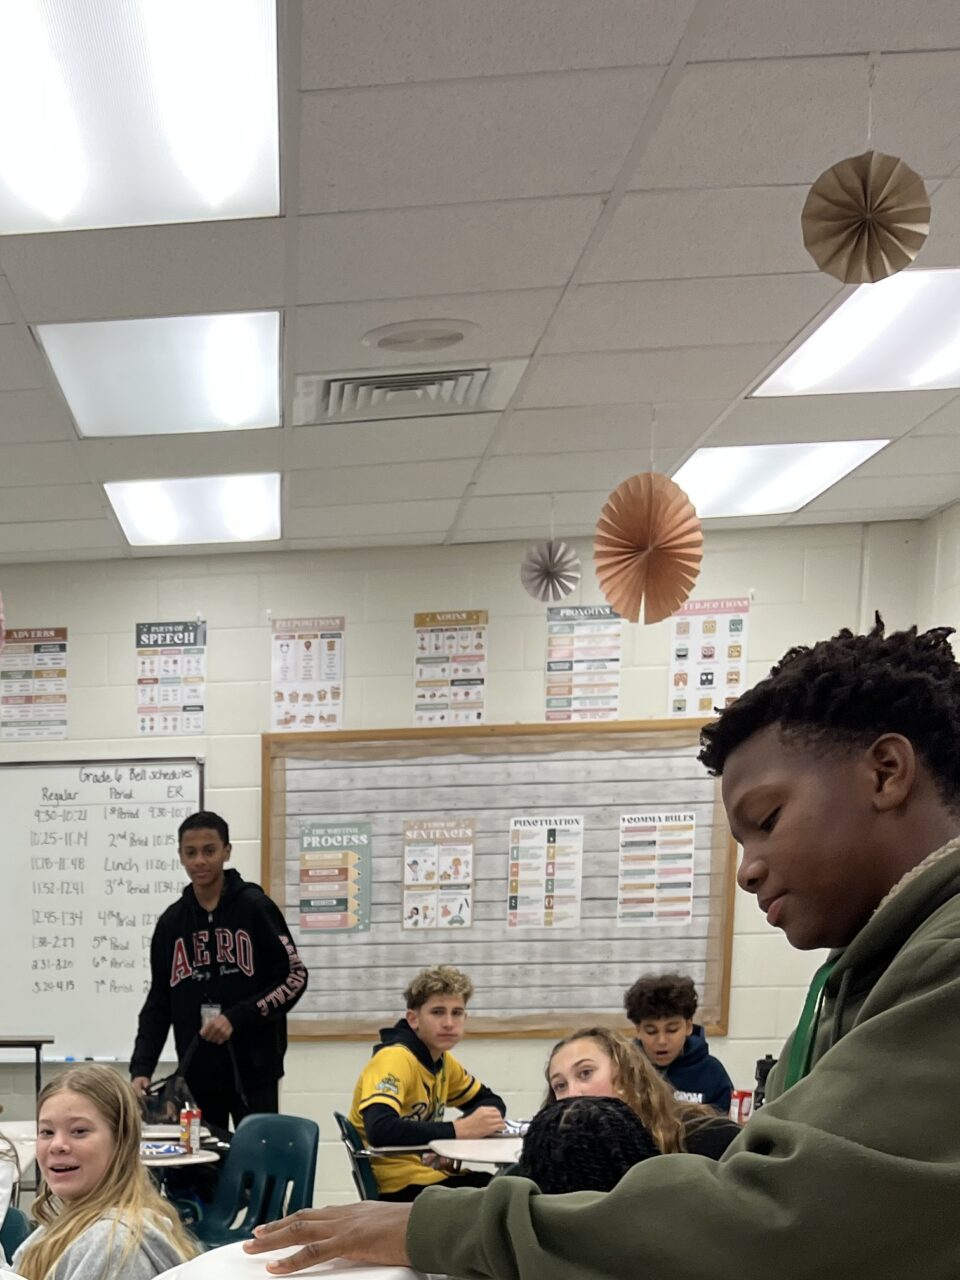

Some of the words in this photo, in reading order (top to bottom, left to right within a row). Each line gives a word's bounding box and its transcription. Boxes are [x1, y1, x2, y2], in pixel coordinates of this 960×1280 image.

[560, 607, 610, 617] PRONOUNS
[11, 629, 56, 639] ADVERBS
[151, 625, 173, 633] PARTS
[140, 632, 195, 645] SPEECH
[79, 766, 112, 783] Grade
[129, 767, 146, 781] Bell
[41, 787, 79, 805] Regular
[109, 787, 134, 799] Period
[167, 785, 184, 798] ER
[514, 818, 580, 827] PUNCTUATION
[627, 815, 662, 824] COMMA
[665, 814, 694, 823] RULES
[405, 828, 473, 840] SENTENCES
[303, 834, 369, 848] PROCESS
[104, 857, 139, 872] Lunch
[126, 880, 149, 894] Period
[170, 928, 254, 988] AERO
